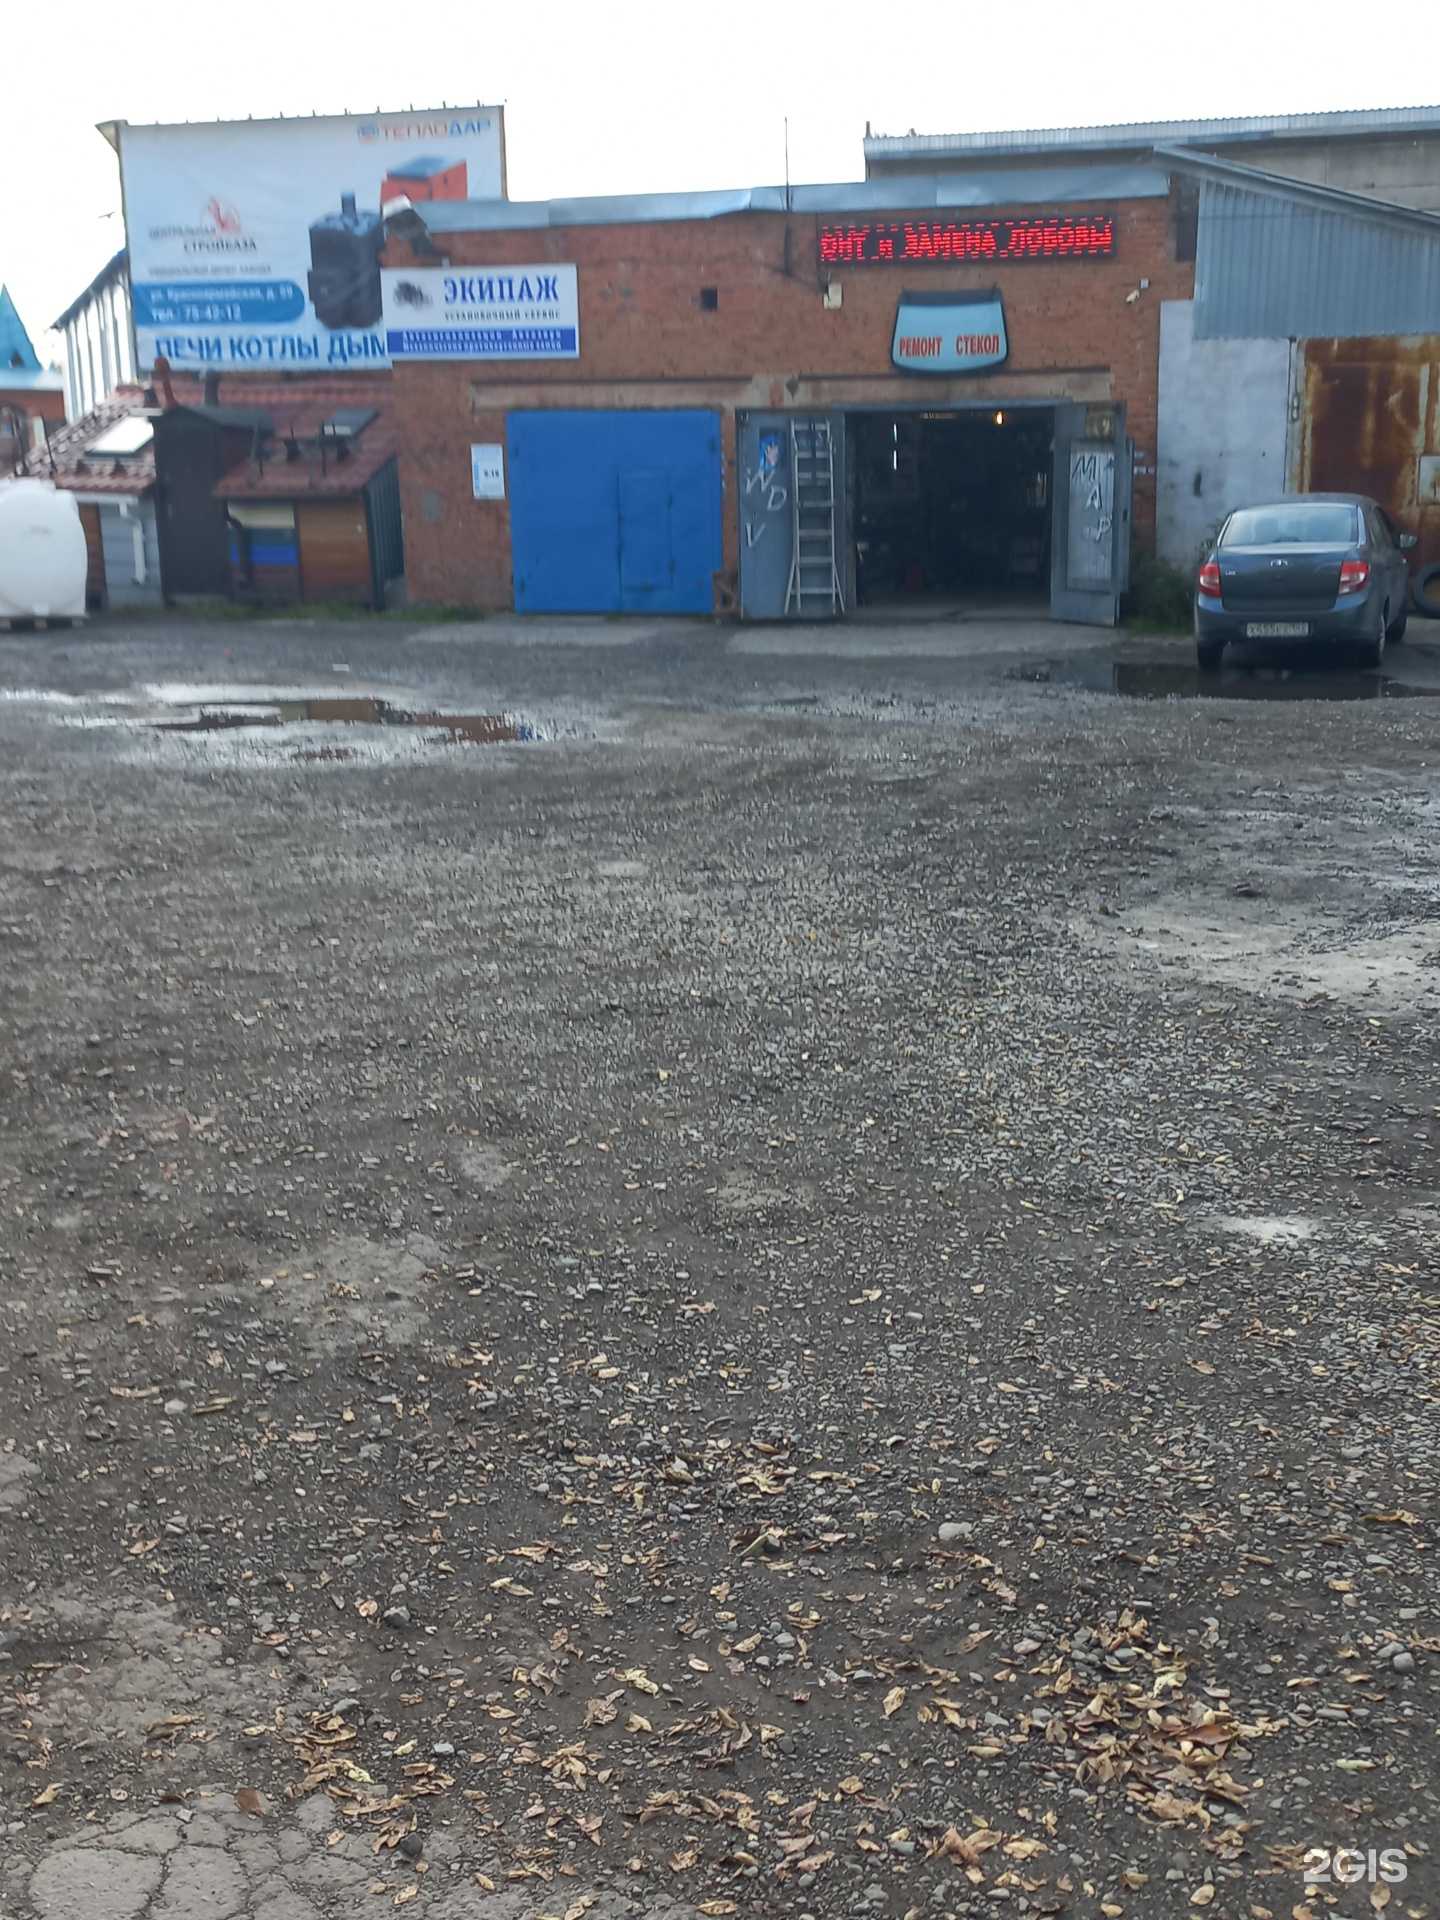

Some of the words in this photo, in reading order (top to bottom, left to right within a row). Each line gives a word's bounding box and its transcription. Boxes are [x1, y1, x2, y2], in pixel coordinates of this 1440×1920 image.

[443, 275, 559, 304] ЭКИПАЖ
[155, 335, 223, 361] ПЕЧИ
[229, 333, 318, 360] КОТЛЫ
[899, 336, 943, 357] РЕМОНТ
[956, 333, 1000, 355] СТЕКОЛ
